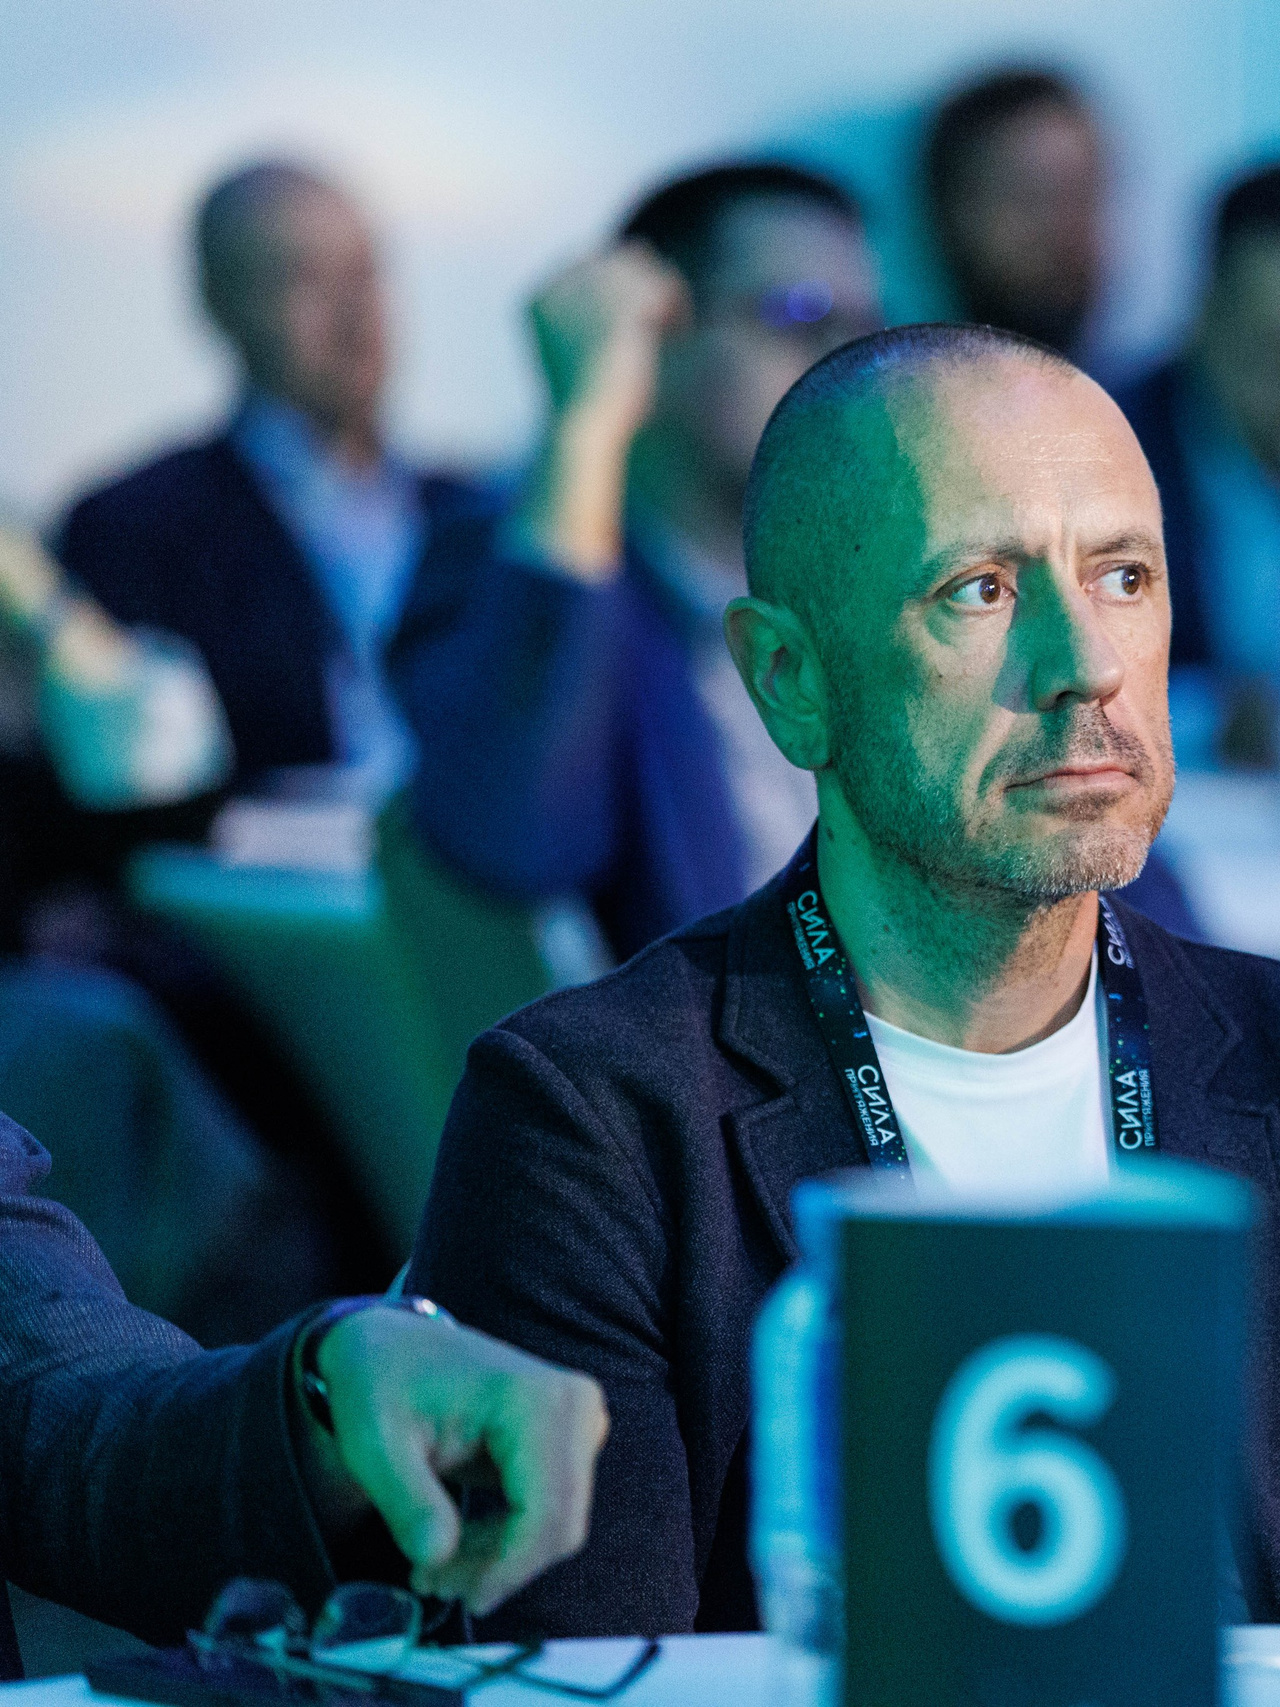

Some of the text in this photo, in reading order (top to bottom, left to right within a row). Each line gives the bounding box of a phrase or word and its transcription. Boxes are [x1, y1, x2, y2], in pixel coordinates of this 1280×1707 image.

[798, 890, 835, 965] СИЛА
[845, 1068, 879, 1146] ПРИТЯЖЕНИЯ
[857, 1065, 896, 1144] СИЛА
[1115, 1069, 1142, 1149] СИЛА
[1139, 1069, 1155, 1146] ПРИТЯЖЕНИЯ
[932, 1336, 1125, 1625] 6
